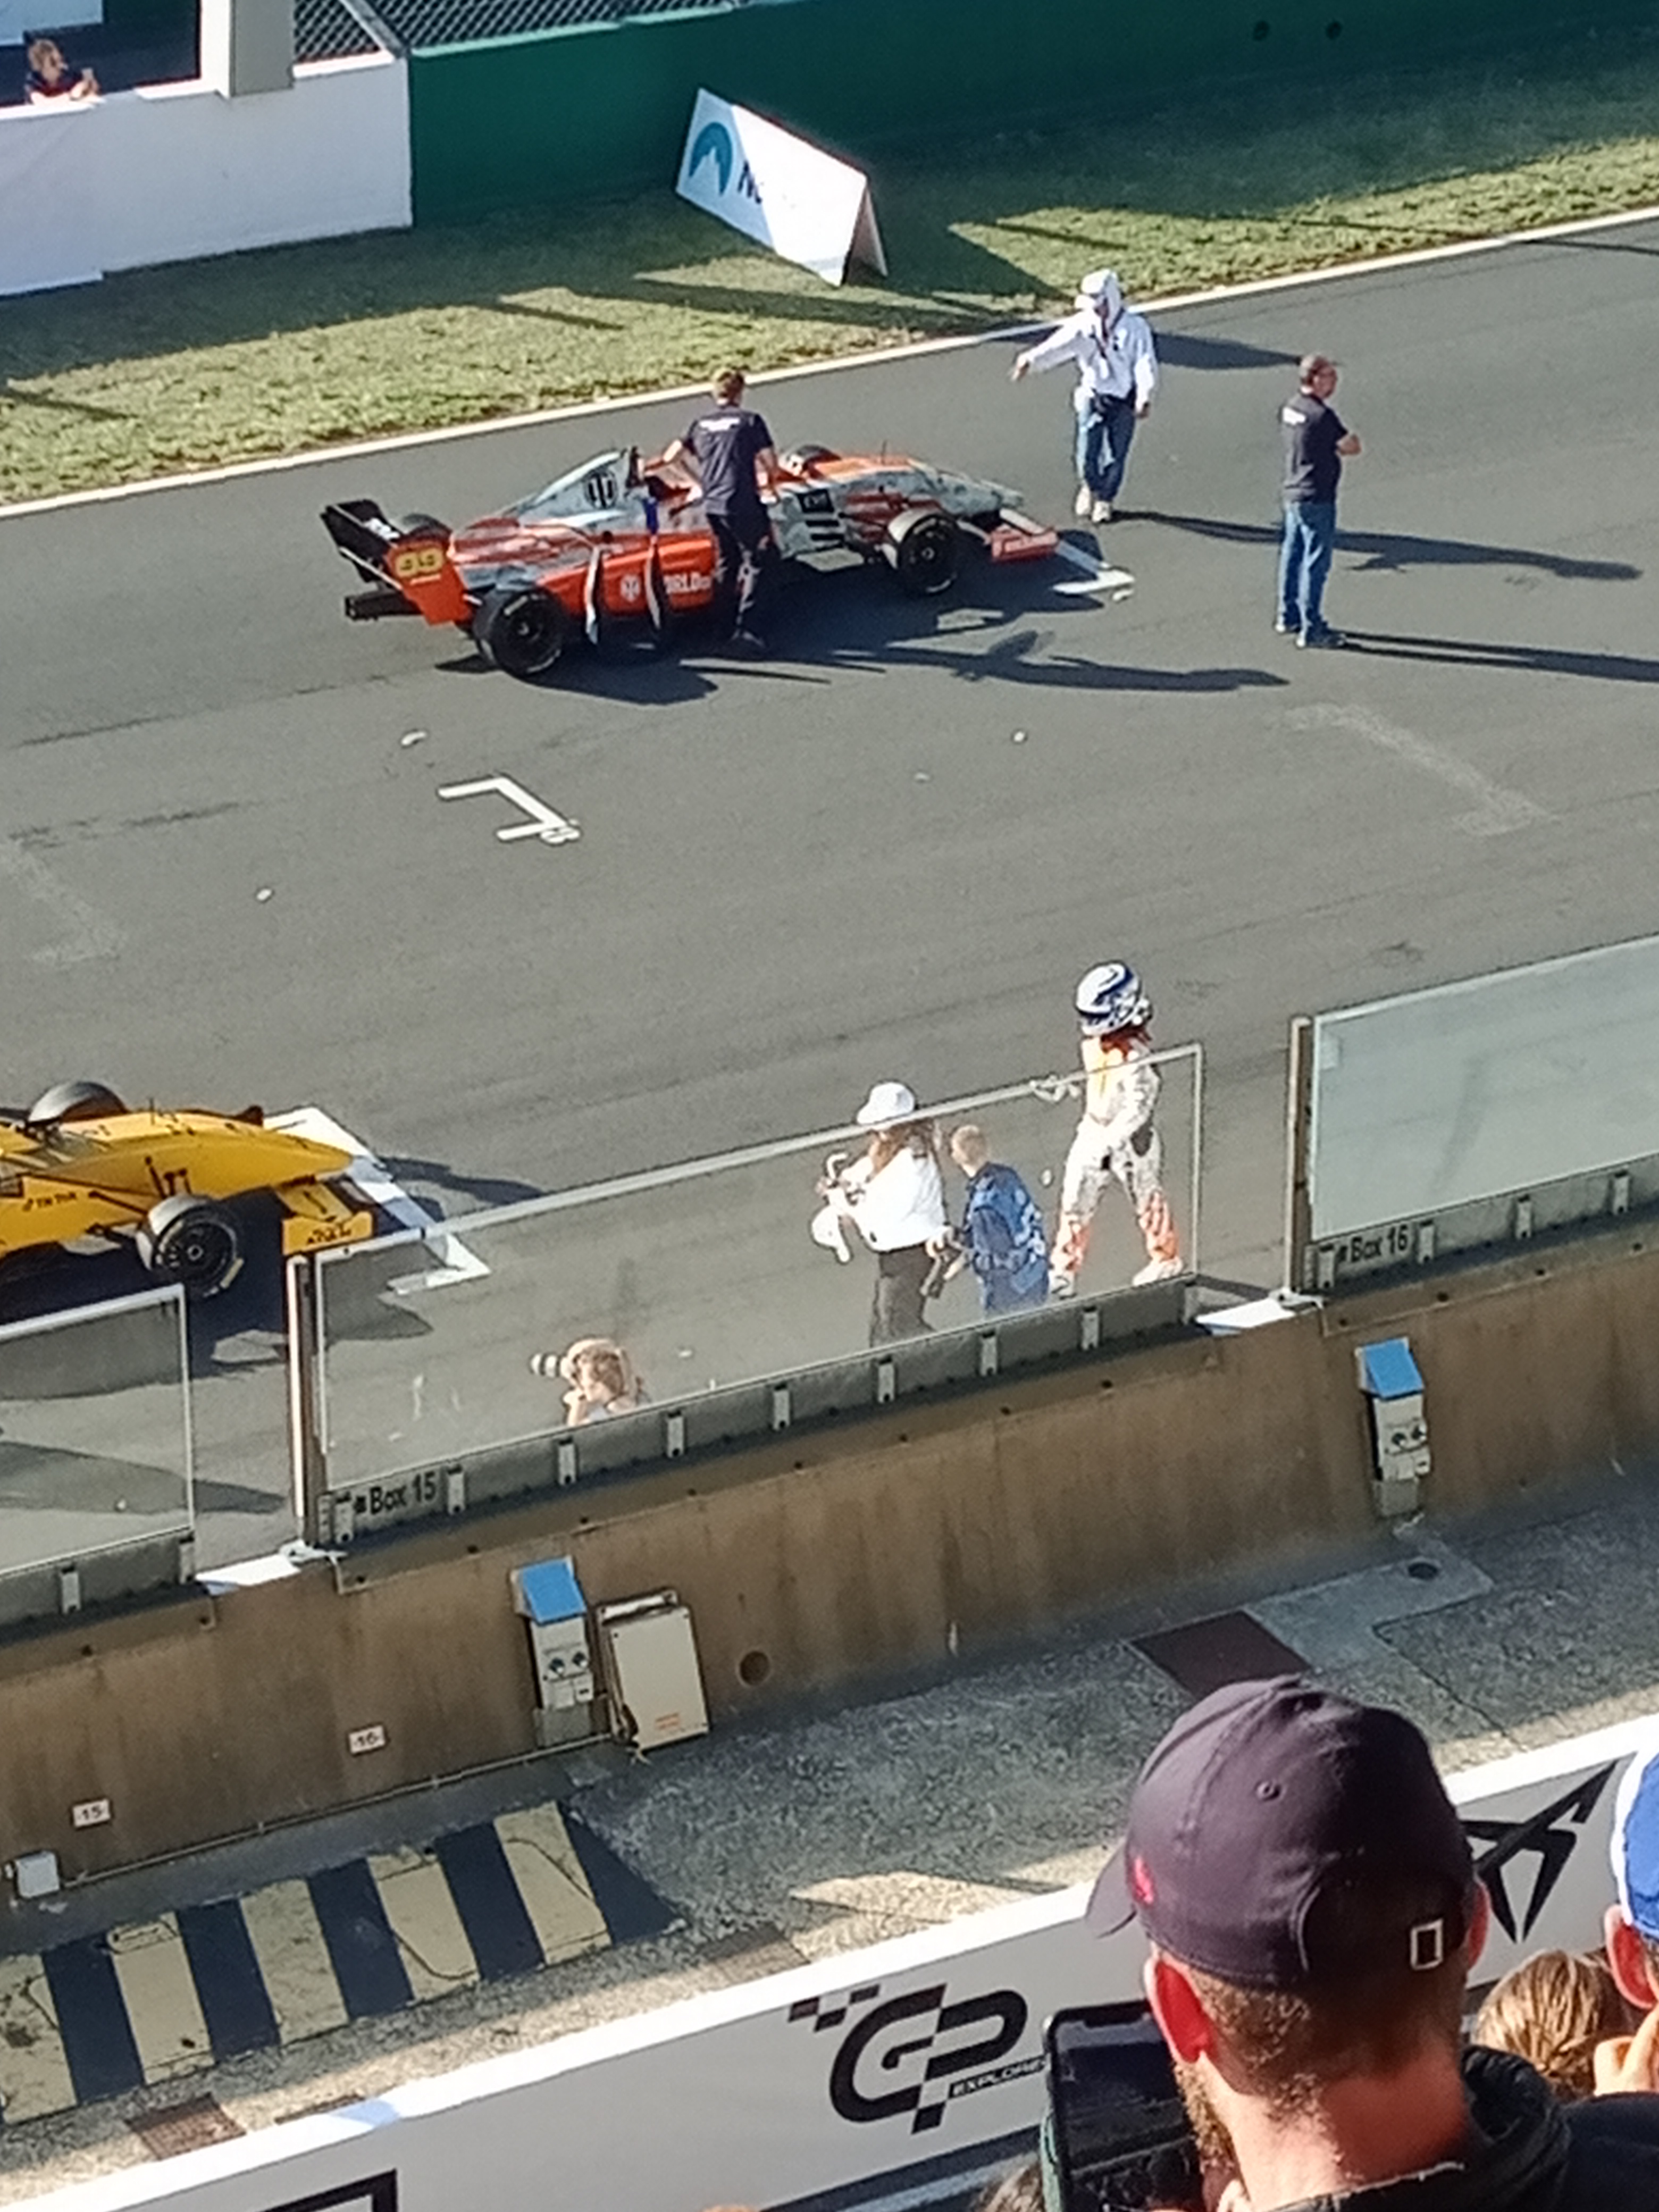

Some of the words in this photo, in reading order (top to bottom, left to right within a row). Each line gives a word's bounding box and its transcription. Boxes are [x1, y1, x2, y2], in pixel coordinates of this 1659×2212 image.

[1351, 1235, 1382, 1263] Box
[1387, 1224, 1409, 1254] 16
[370, 1486, 407, 1515] Box
[412, 1470, 437, 1502] 15
[830, 1982, 1028, 2134] GP
